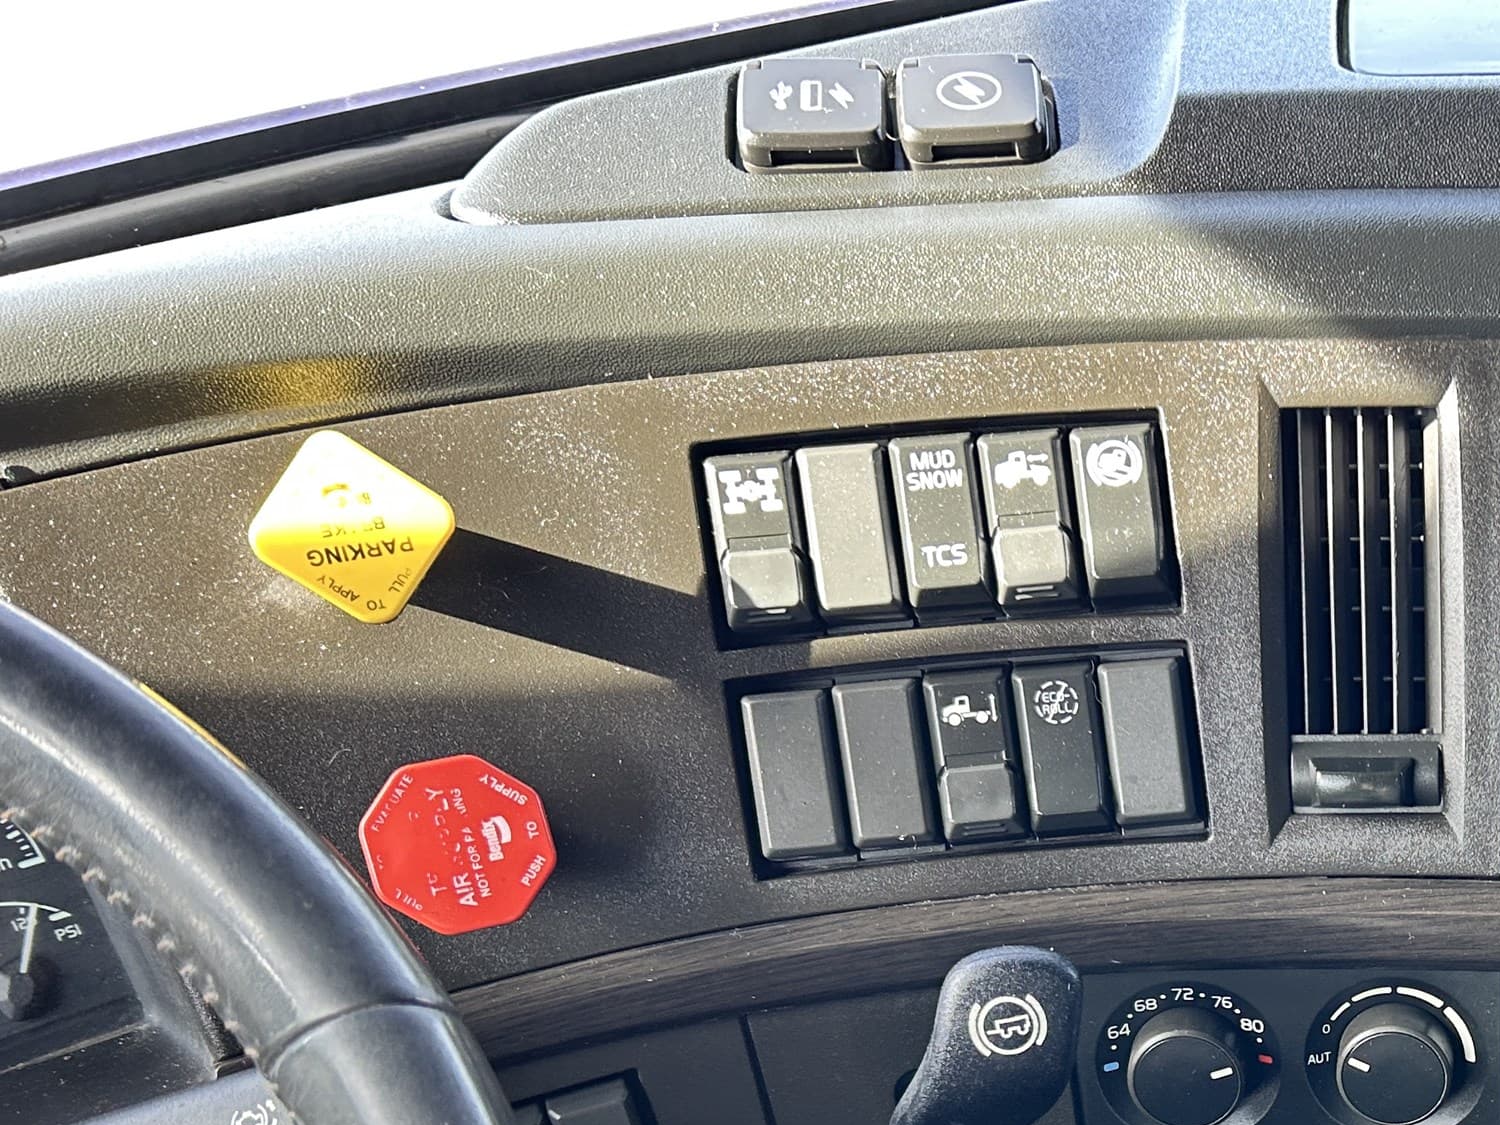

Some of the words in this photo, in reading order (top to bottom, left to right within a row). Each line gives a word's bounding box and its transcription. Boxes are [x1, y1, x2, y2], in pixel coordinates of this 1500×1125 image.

[909, 449, 956, 472] MUD
[906, 468, 963, 492] SNOW
[306, 536, 415, 567] PARKING
[921, 543, 969, 569] TCS
[316, 574, 360, 602] APPLY
[387, 567, 413, 593] PULL
[366, 599, 388, 611] TO
[479, 773, 528, 806] SUPPLY
[525, 820, 540, 839] TO
[467, 844, 484, 871] FOR
[520, 854, 547, 887] PUSH
[452, 872, 479, 906] AIR
[474, 873, 492, 898] NOT
[10, 916, 37, 932] 12
[54, 923, 82, 942] PSI
[1134, 998, 1158, 1013] 68
[1171, 987, 1195, 1001] 72
[1211, 995, 1233, 1009] 76
[1107, 1023, 1131, 1040] 64
[1240, 1018, 1265, 1034] 80
[1307, 1051, 1332, 1066] AUT
